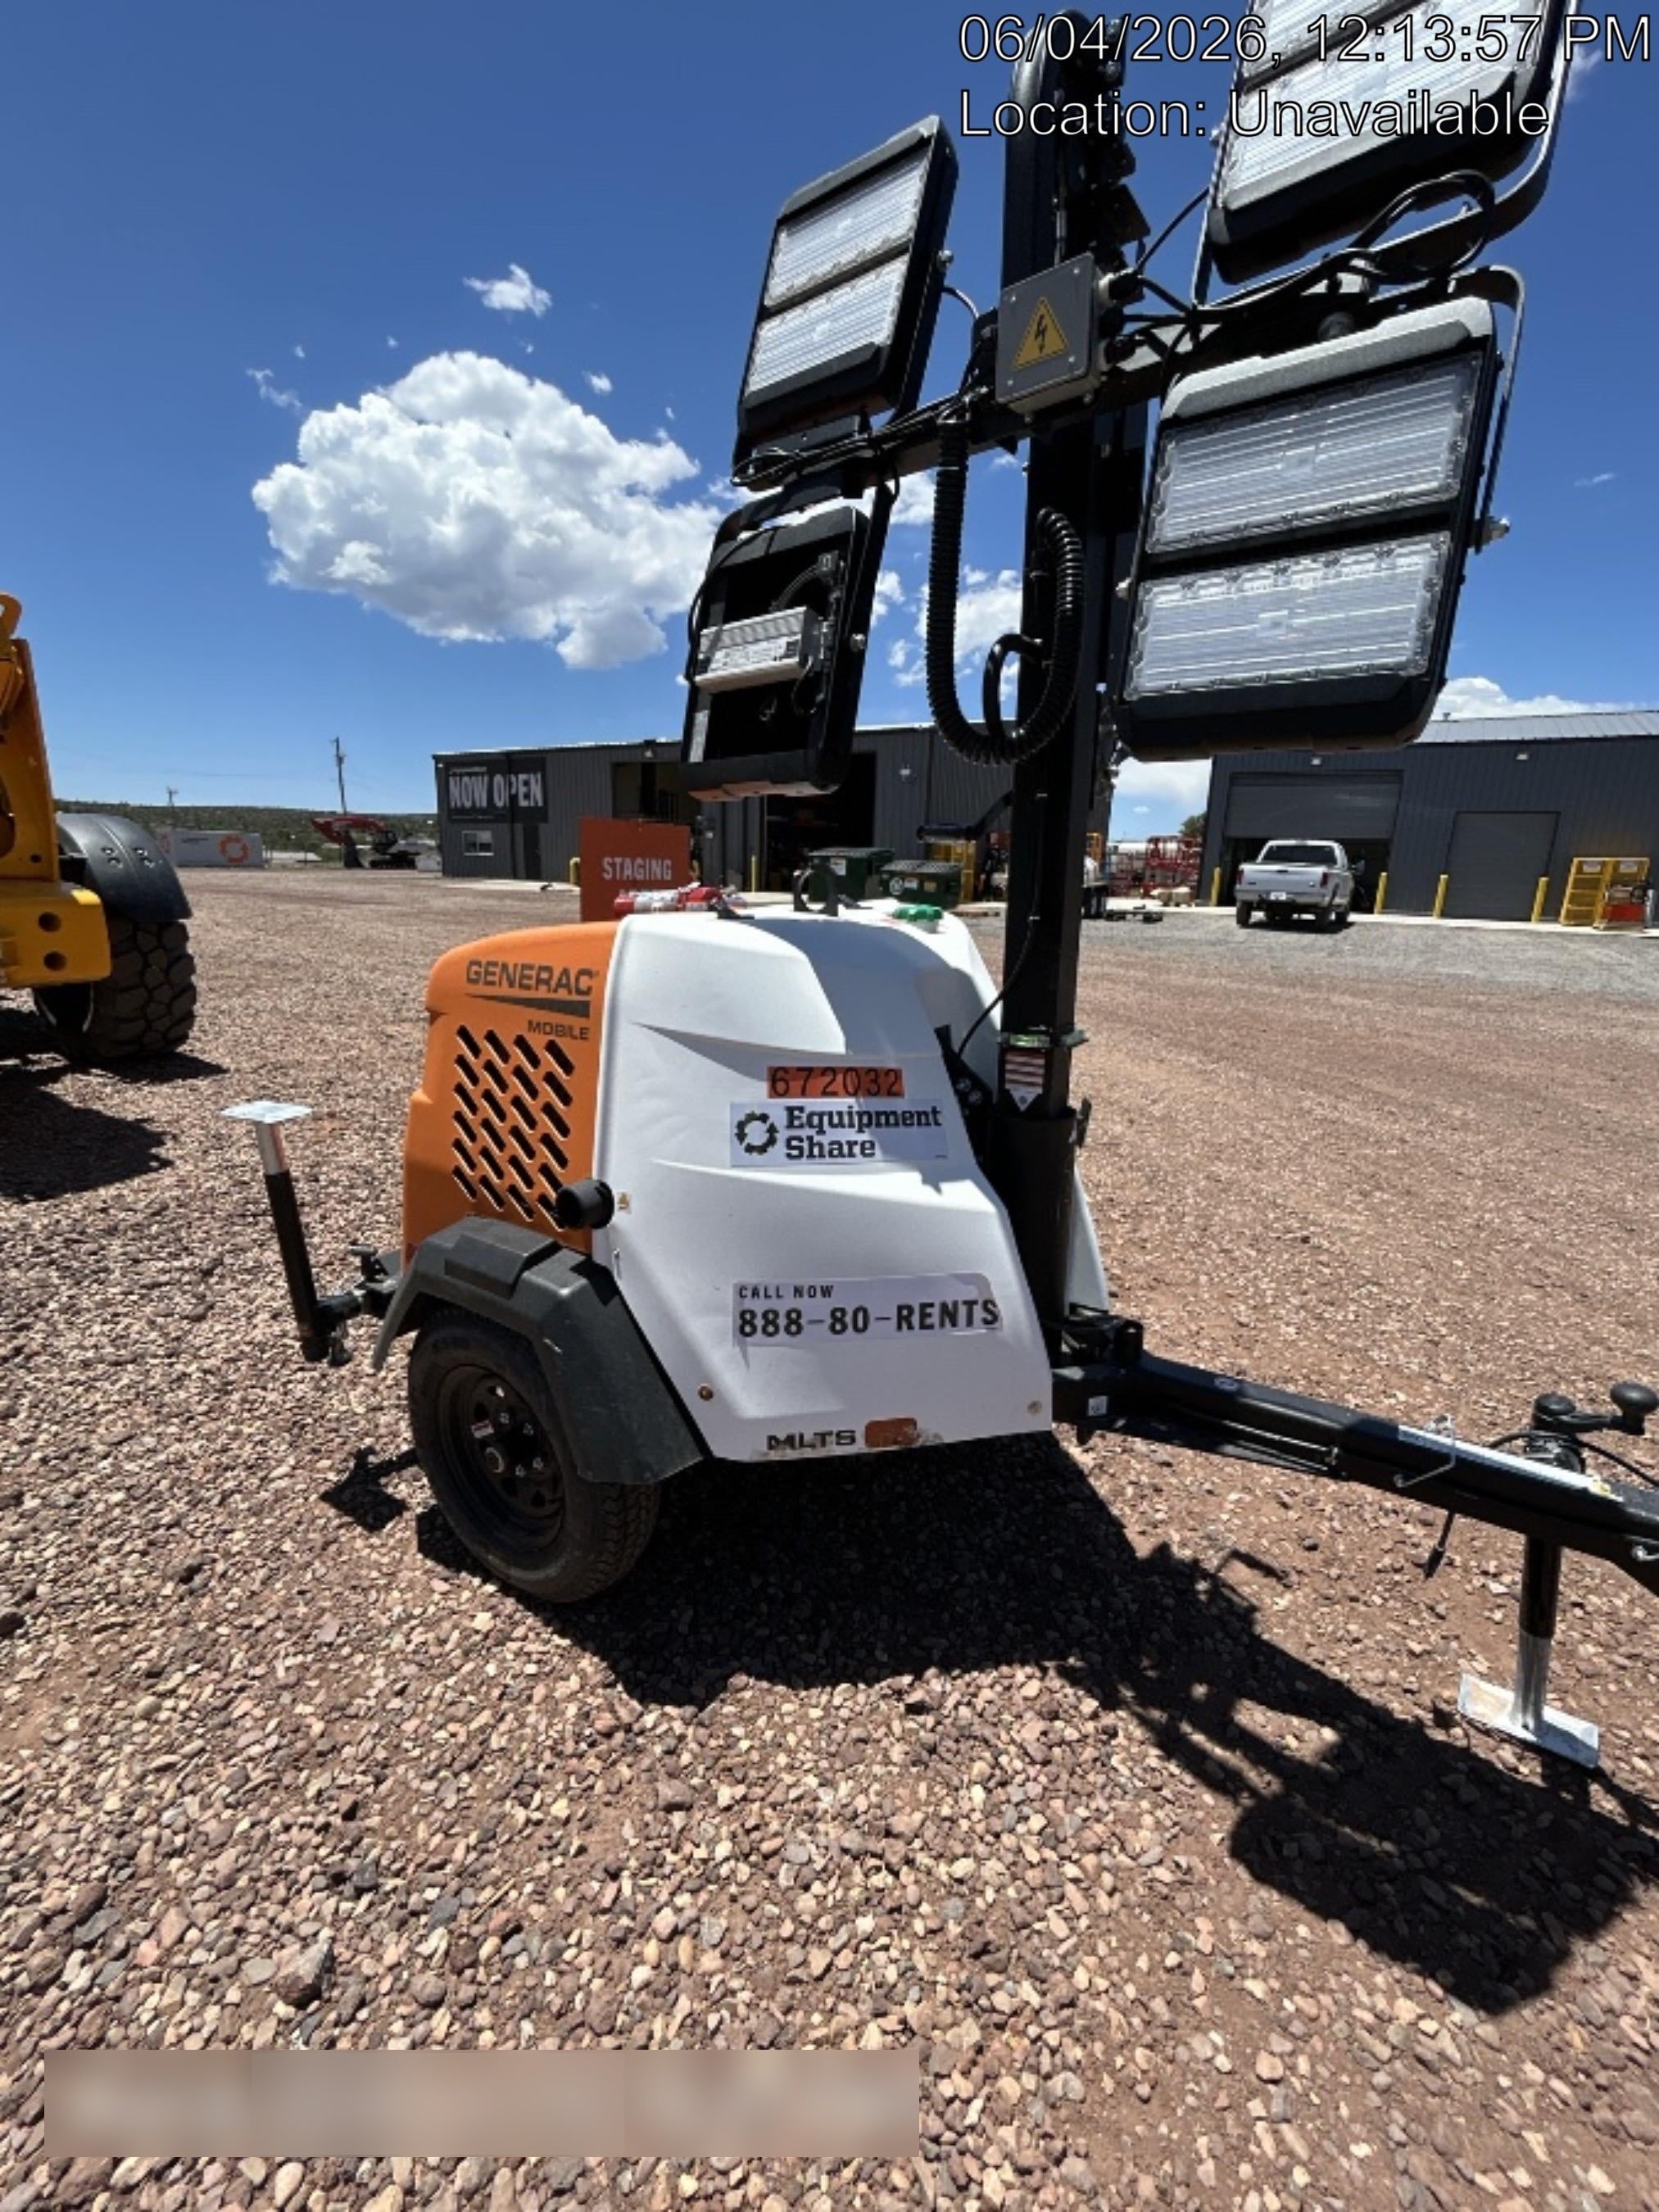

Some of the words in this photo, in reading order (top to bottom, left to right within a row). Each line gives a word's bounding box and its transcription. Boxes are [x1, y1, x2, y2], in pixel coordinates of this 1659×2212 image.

[449, 774, 487, 809] NOW
[493, 771, 544, 808] OPEN
[602, 857, 672, 882] STAGING
[465, 960, 594, 996] GENERAC
[528, 1020, 590, 1041] MOBILE
[771, 1067, 900, 1097] 672032
[784, 1106, 942, 1135] Equipment
[785, 1135, 877, 1160] Share
[739, 1285, 784, 1299] CALL
[793, 1285, 834, 1299] NOW
[767, 1430, 856, 1451] MLTS
